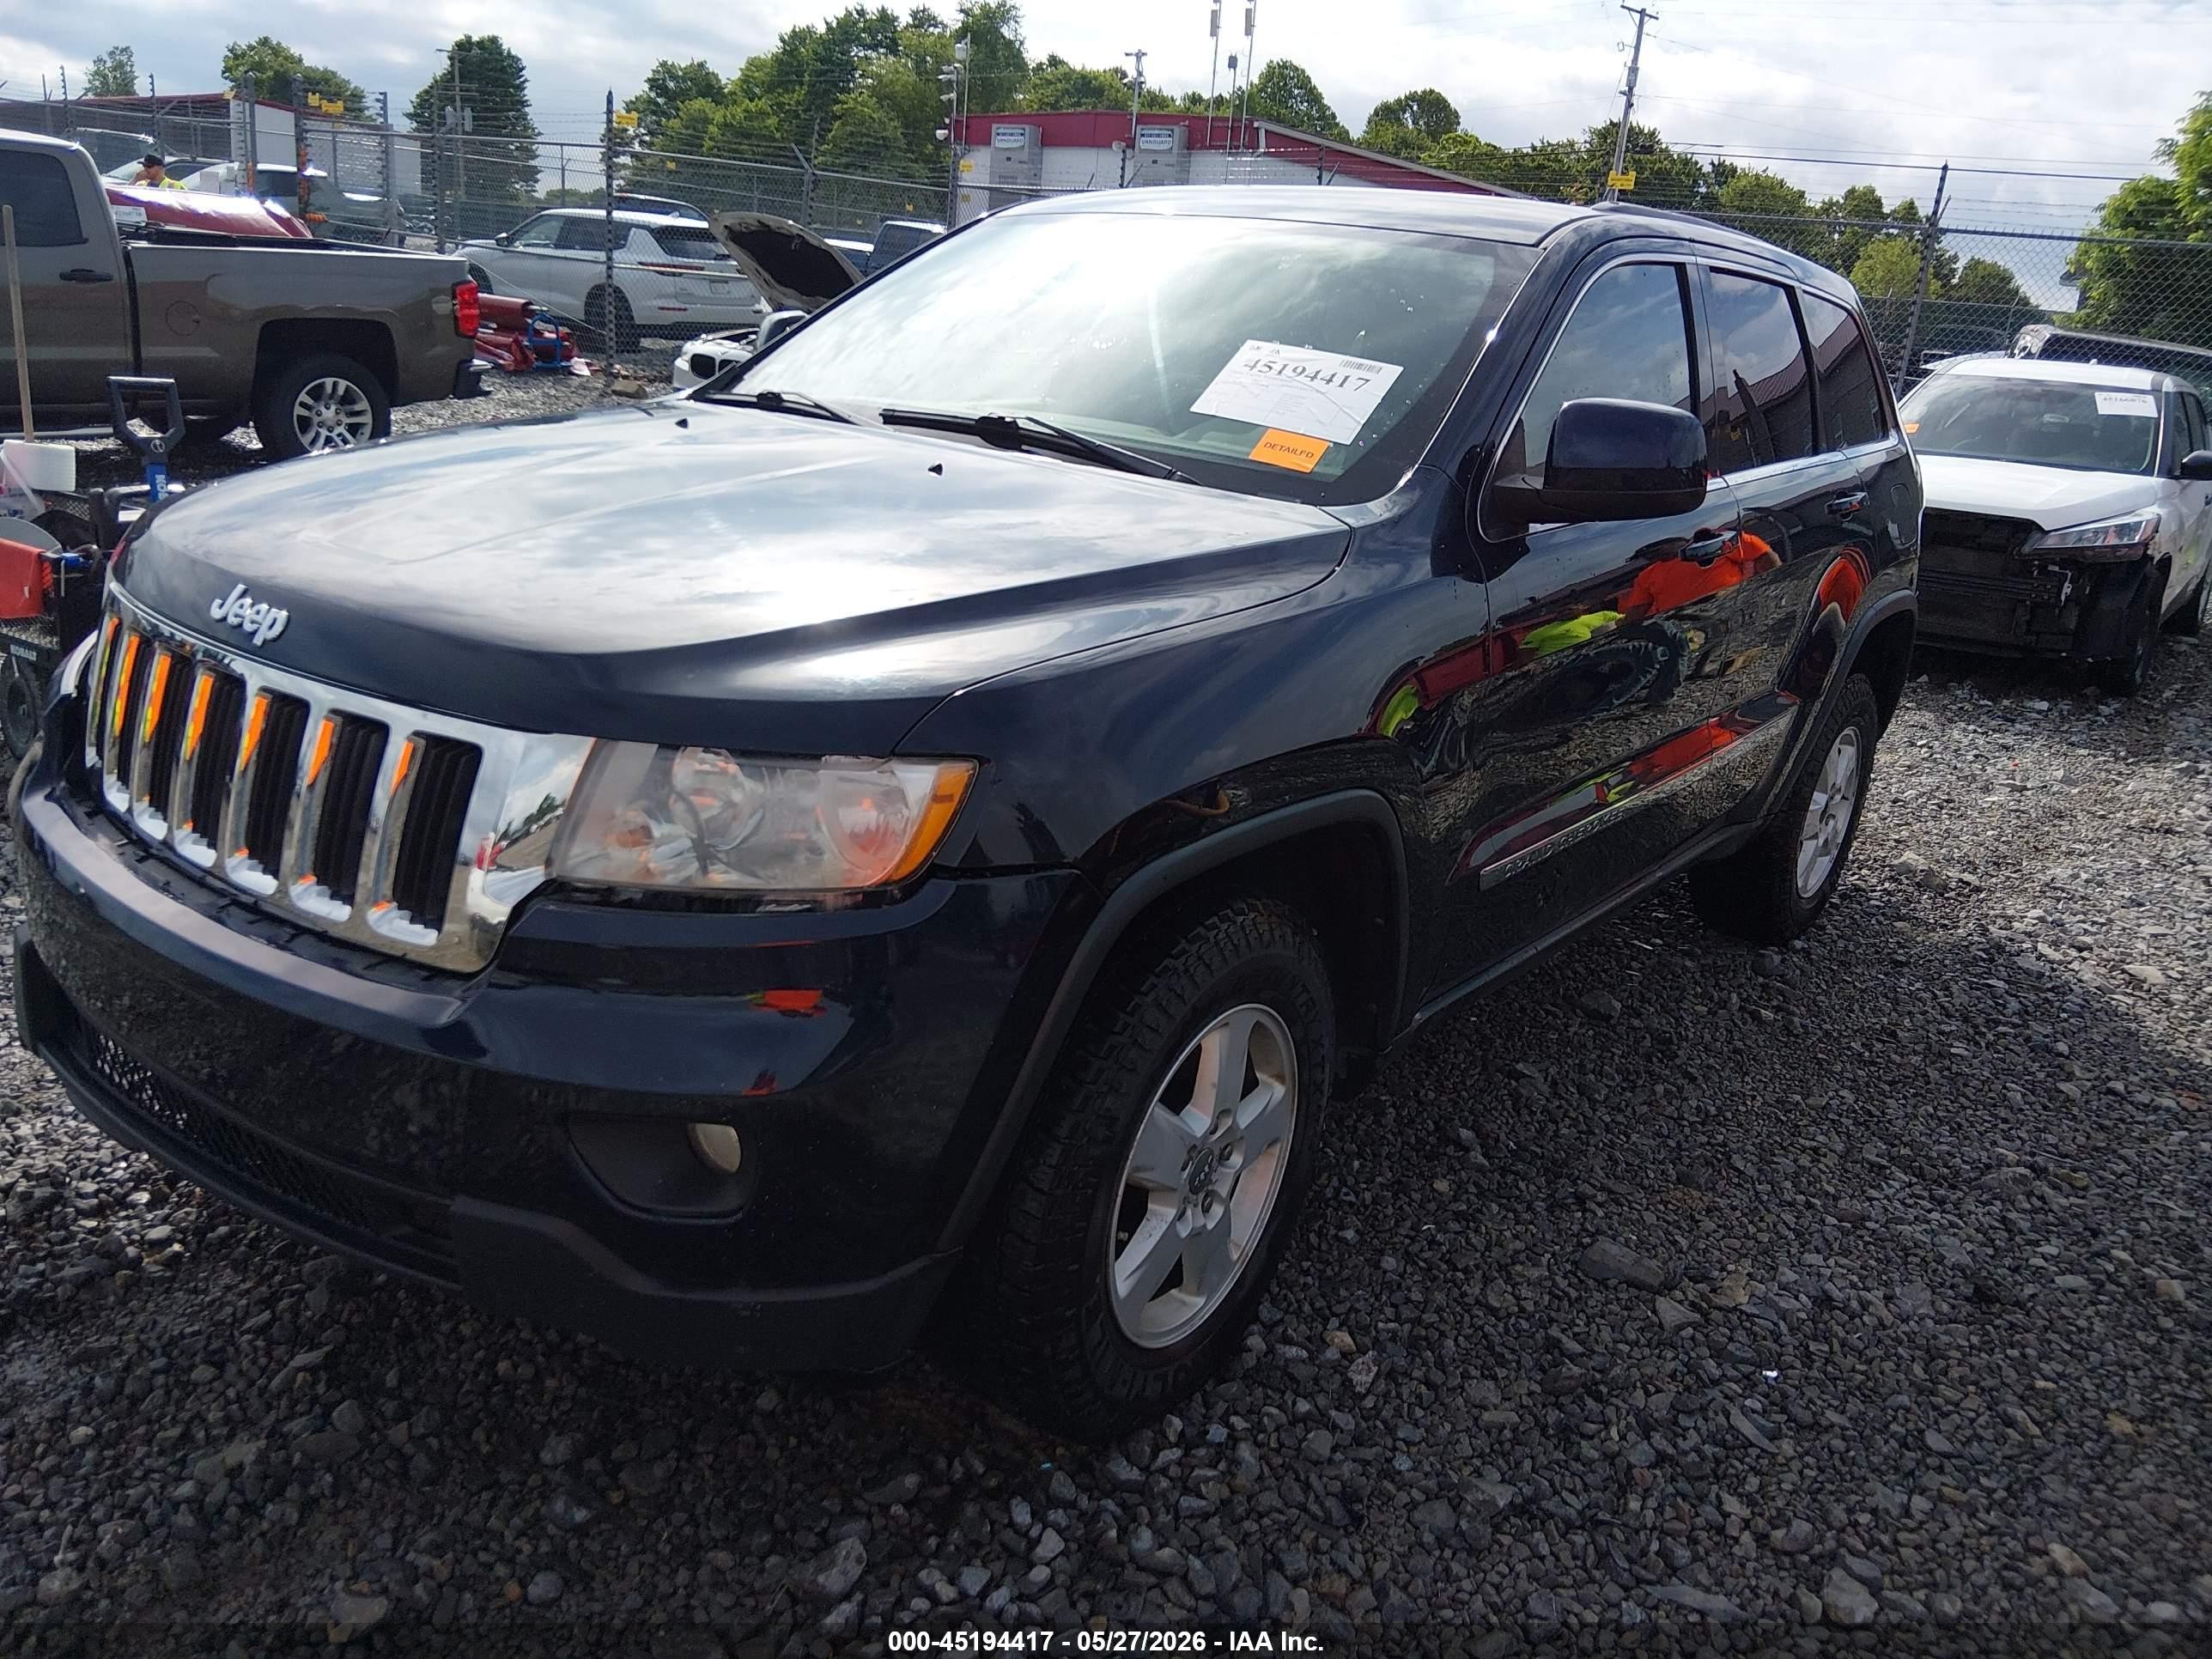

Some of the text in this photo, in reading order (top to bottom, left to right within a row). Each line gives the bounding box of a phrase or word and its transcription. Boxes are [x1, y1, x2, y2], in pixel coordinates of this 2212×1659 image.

[1243, 357, 1371, 392] 45194417
[1263, 441, 1315, 459] DETAILED
[210, 583, 289, 647] Jeep
